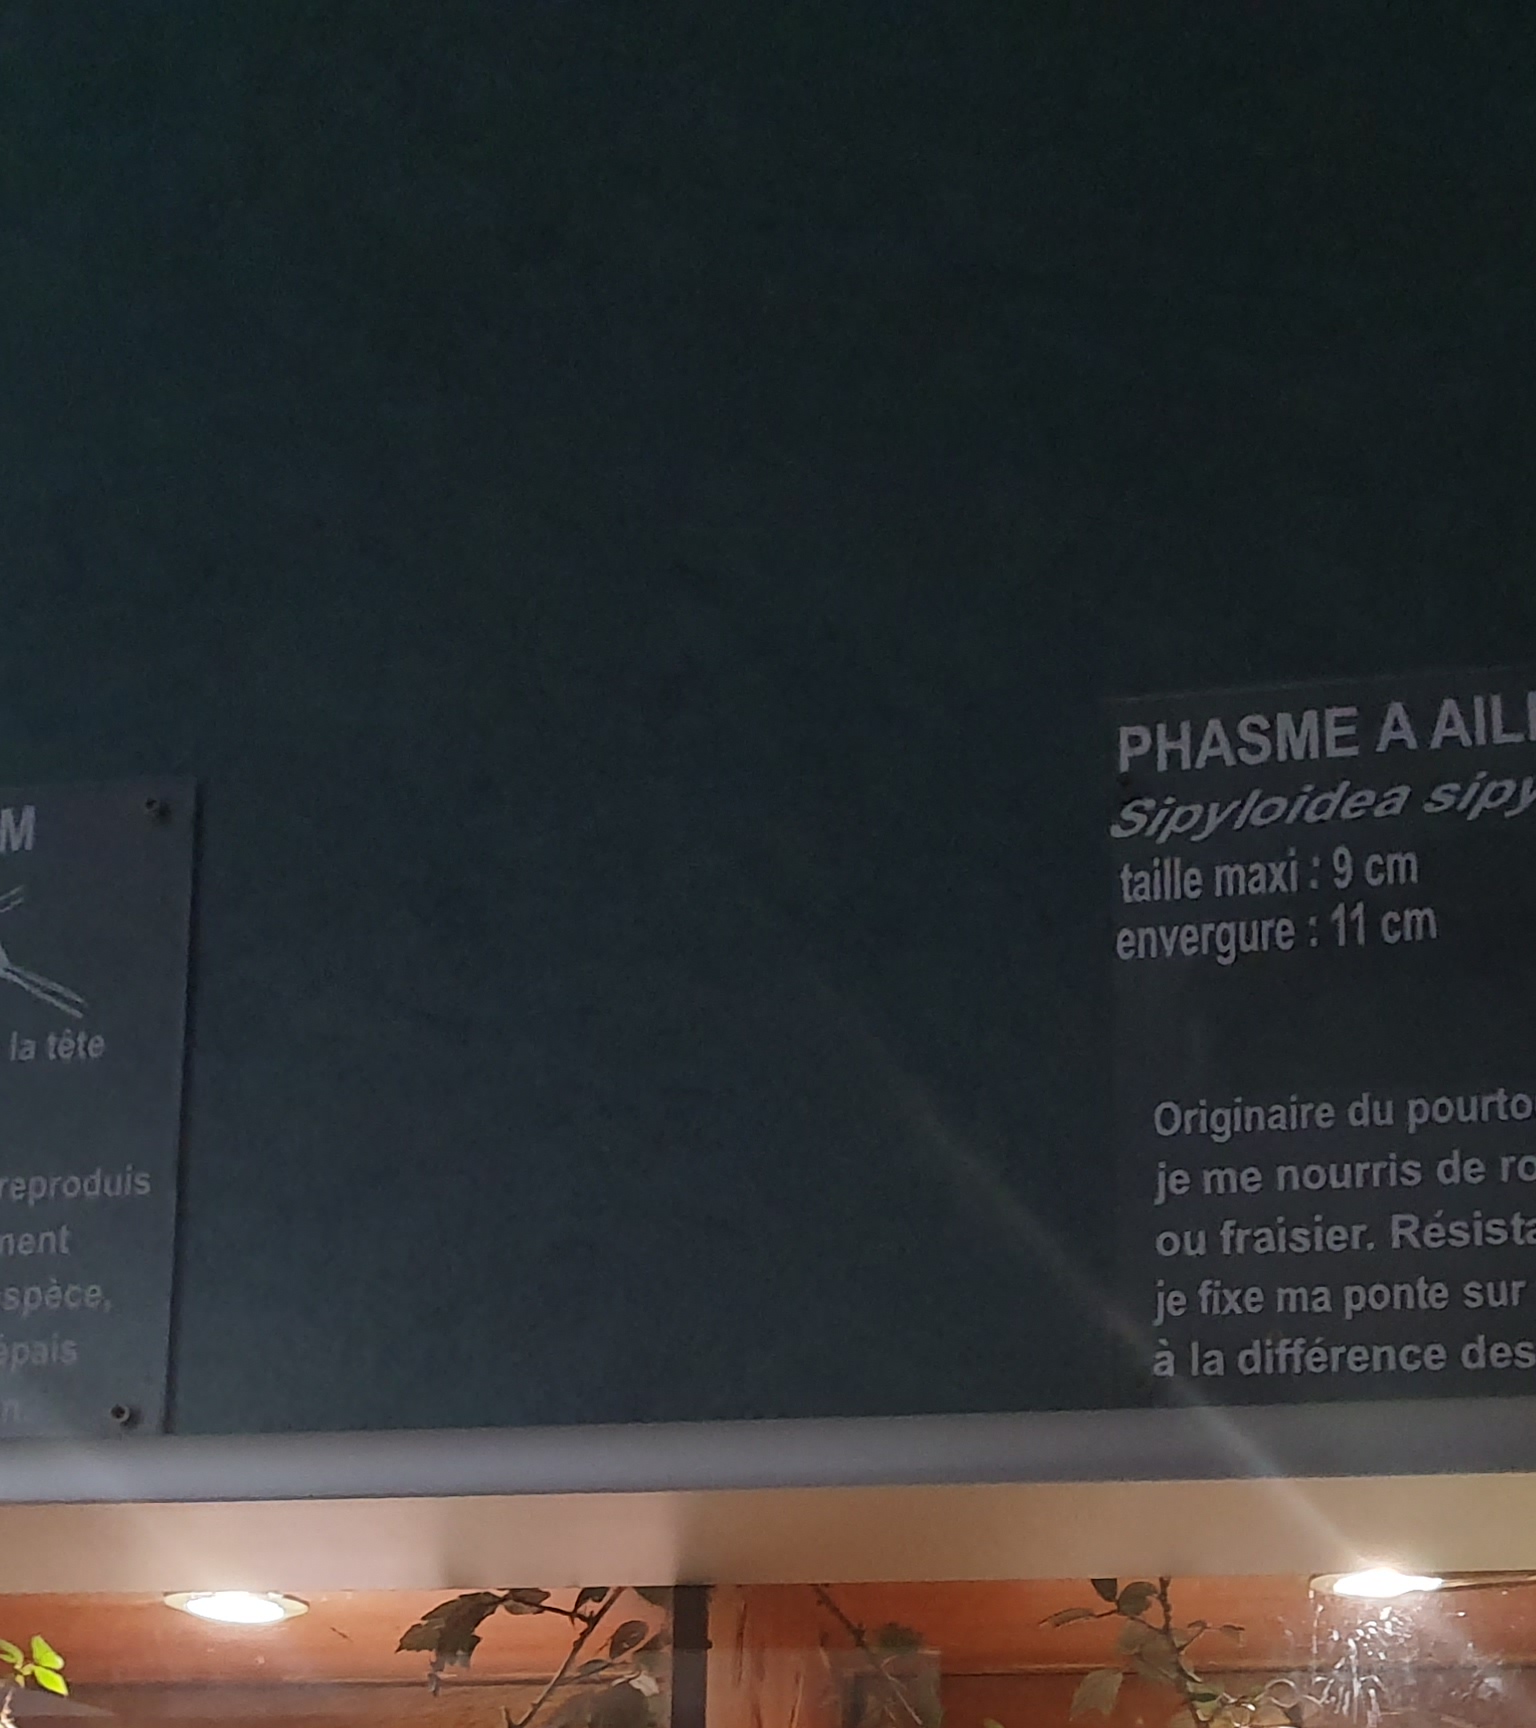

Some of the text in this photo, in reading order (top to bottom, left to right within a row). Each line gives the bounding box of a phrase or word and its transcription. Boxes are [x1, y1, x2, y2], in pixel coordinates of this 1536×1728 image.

[1117, 707, 1360, 772] PHASME
[1376, 701, 1416, 752] A
[1111, 779, 1413, 846] Sipyloidea
[1121, 856, 1204, 903] taille
[1213, 851, 1299, 895] maxi
[1332, 846, 1354, 888] 9
[1364, 852, 1418, 888] cm
[1117, 910, 1297, 966] envergure
[1333, 901, 1369, 945] 11
[1380, 907, 1438, 944] cm
[11, 1029, 39, 1060] la
[46, 1026, 105, 1060] tête
[1154, 1099, 1335, 1142] Originaire
[1348, 1092, 1398, 1128] du
[1154, 1160, 1191, 1204] je
[1203, 1163, 1263, 1195] me
[1276, 1152, 1422, 1192] nourris
[1436, 1147, 1487, 1186] de
[1155, 1224, 1207, 1259] ou
[1219, 1217, 1375, 1254] fraisier.
[1153, 1282, 1187, 1321] je
[1198, 1279, 1265, 1316] fixe
[1275, 1282, 1333, 1313] ma
[1343, 1278, 1448, 1319] ponte
[1462, 1276, 1523, 1308] sur
[1152, 1338, 1176, 1378] à
[1189, 1339, 1225, 1377] la
[1237, 1331, 1446, 1374] différence
[1461, 1331, 1536, 1369] des
